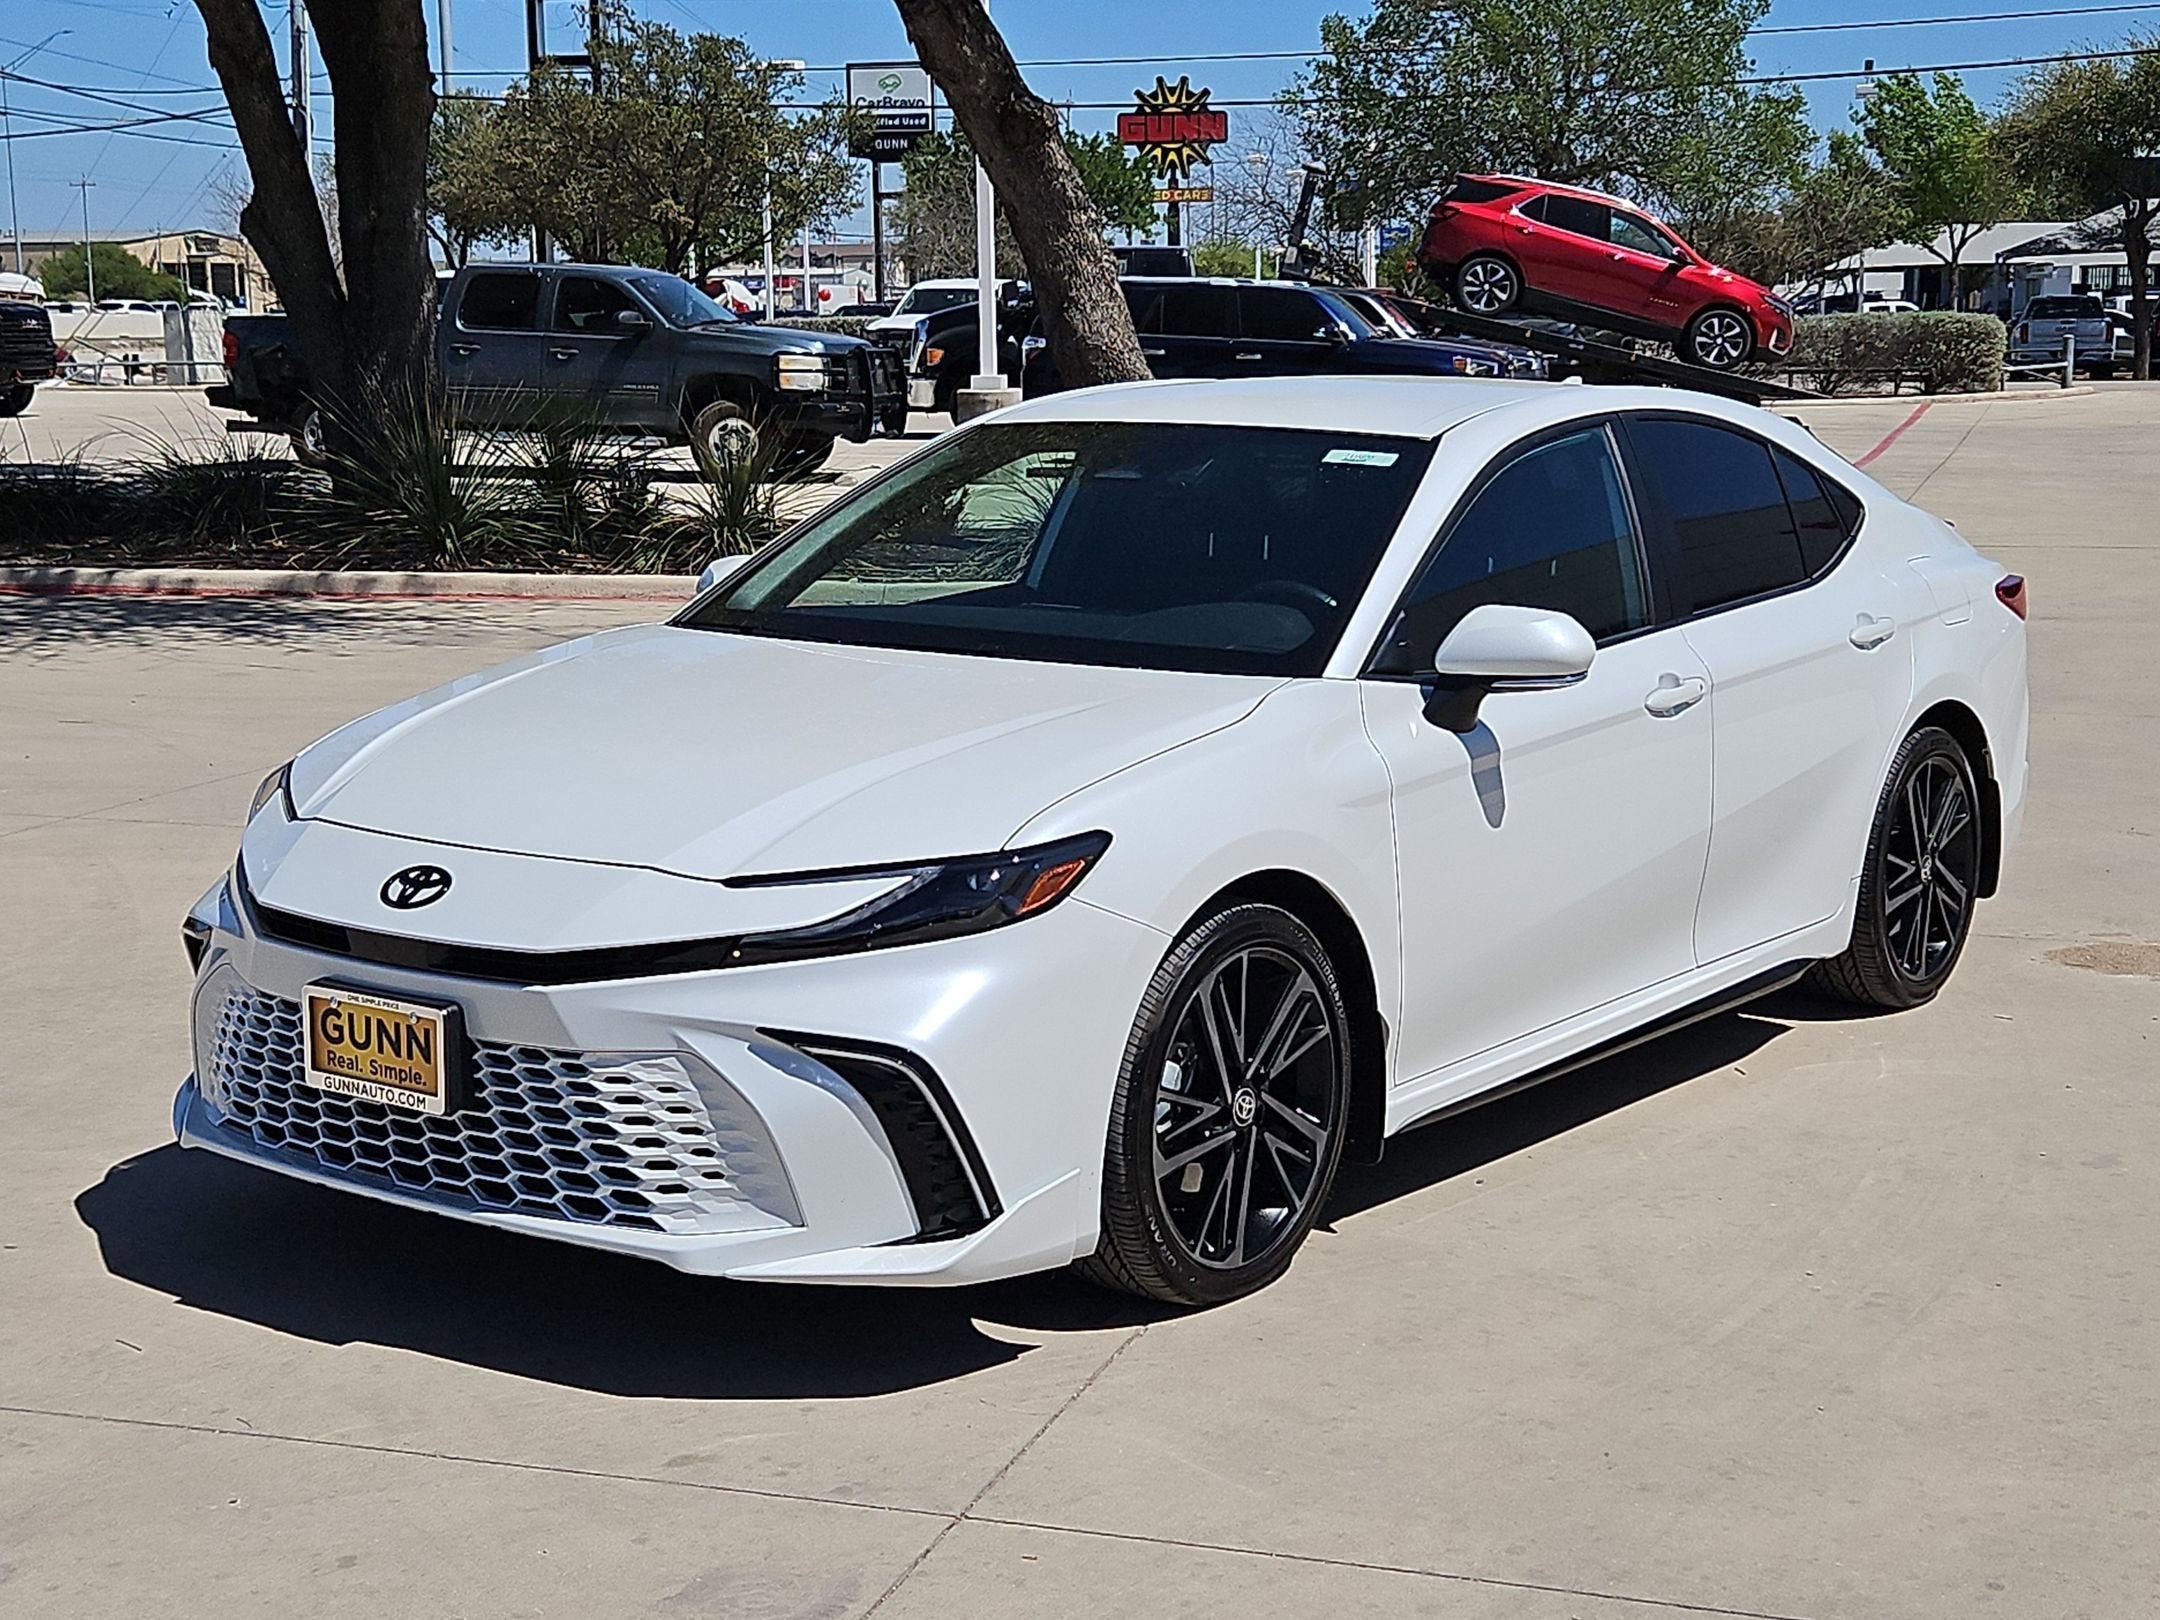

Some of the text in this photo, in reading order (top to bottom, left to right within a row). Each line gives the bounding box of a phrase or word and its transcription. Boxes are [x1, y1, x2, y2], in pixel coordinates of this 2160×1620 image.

[855, 96, 925, 108] CarBravo
[902, 117, 926, 126] Used
[1120, 112, 1226, 142] GUNN
[875, 139, 908, 149] GUNN
[1174, 190, 1209, 200] CARS
[320, 1007, 432, 1065] GUNN
[327, 1050, 427, 1087] Real. Simple.
[324, 1076, 427, 1110] GUNNAUTO.COM
